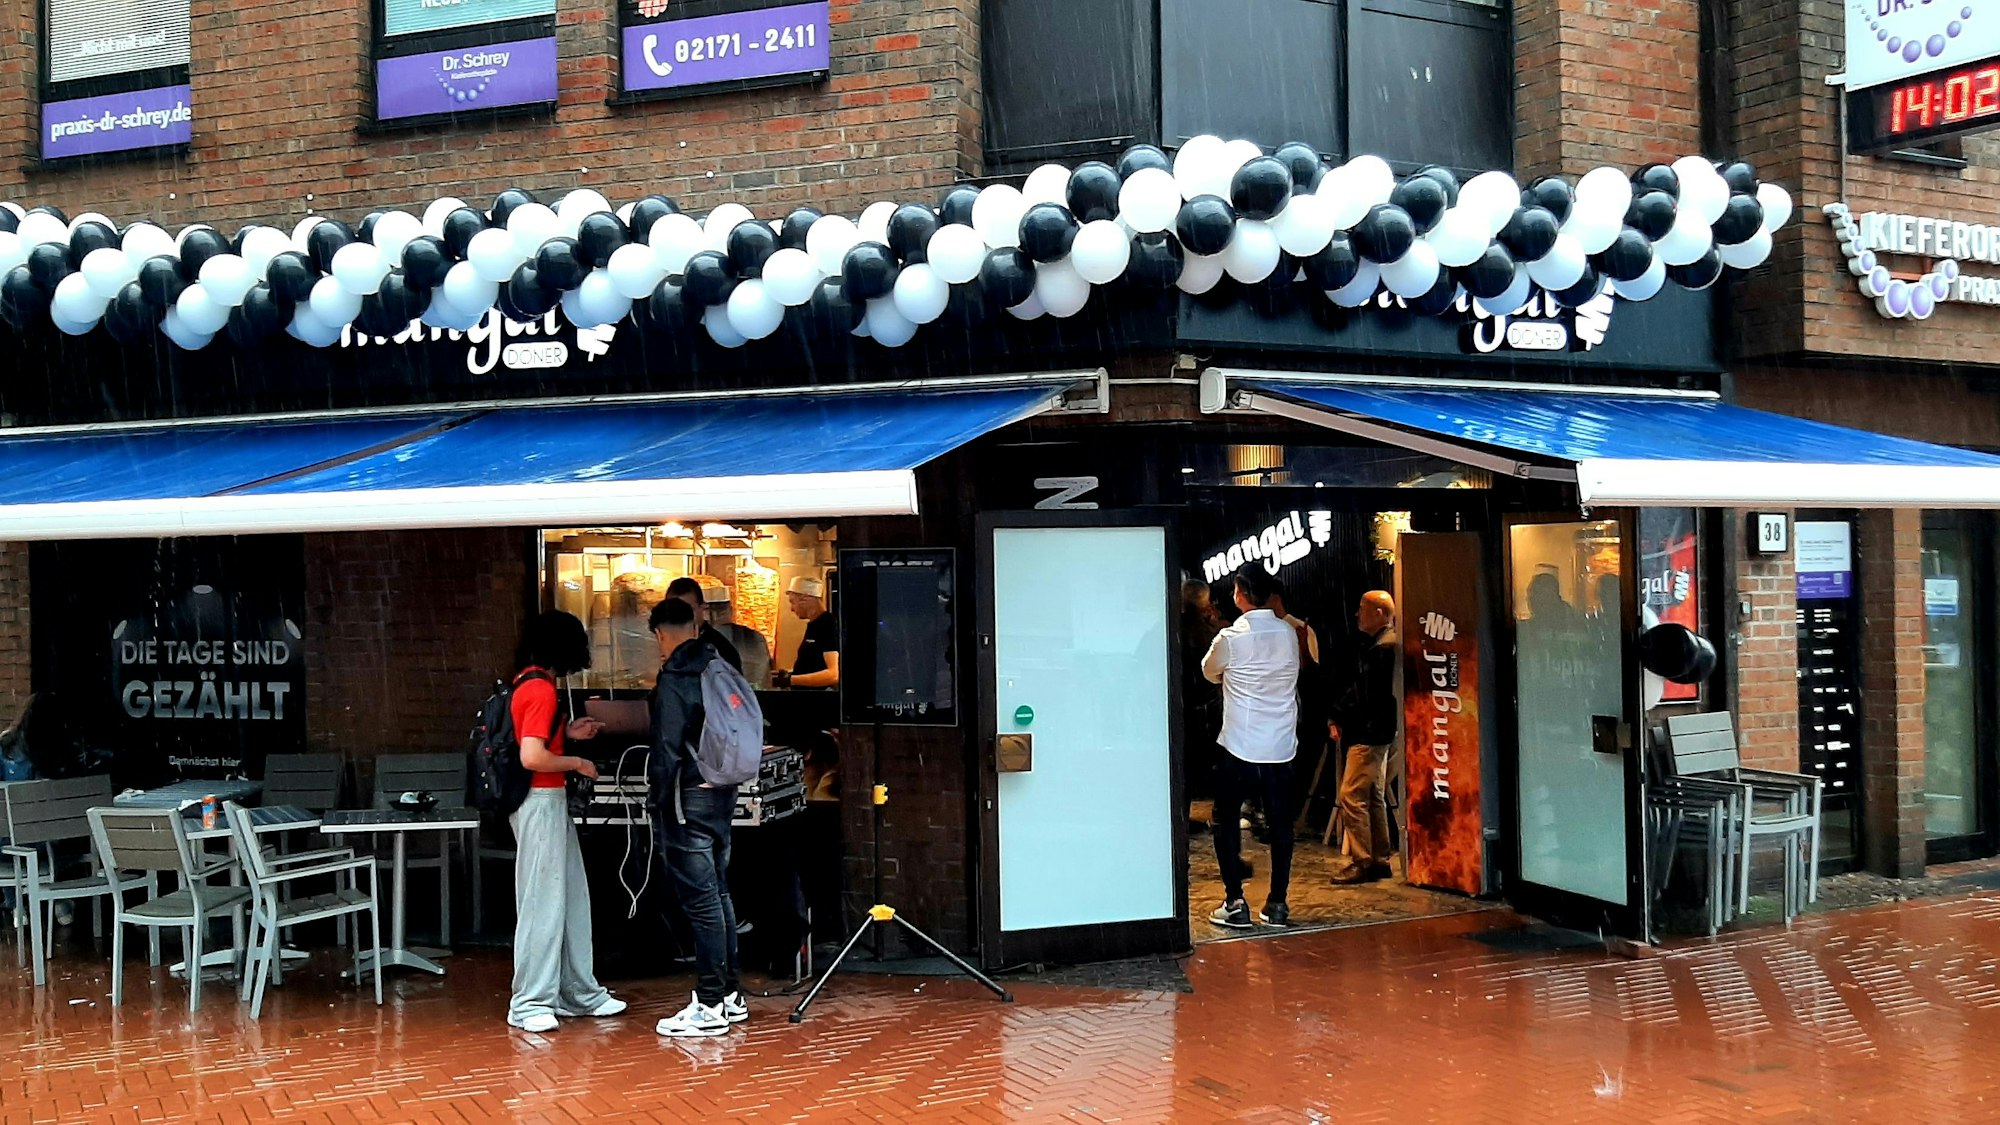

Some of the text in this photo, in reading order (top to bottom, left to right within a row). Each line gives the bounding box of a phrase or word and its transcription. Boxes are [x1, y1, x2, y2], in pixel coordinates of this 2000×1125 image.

[443, 52, 510, 71] Dr. Schrey
[674, 33, 741, 63] 02171
[765, 23, 815, 52] 2411
[1892, 68, 2000, 133] 14:02
[51, 101, 191, 142] praxis-dr-schrey.de
[1958, 276, 2000, 304] PRA
[1203, 511, 1304, 584] mangal
[1765, 522, 1781, 541] 38
[121, 641, 290, 665] DIE TAGE SIND
[122, 671, 290, 720] GEZÄHLT
[1424, 649, 1462, 799] mangal
[222, 757, 241, 767] hier
